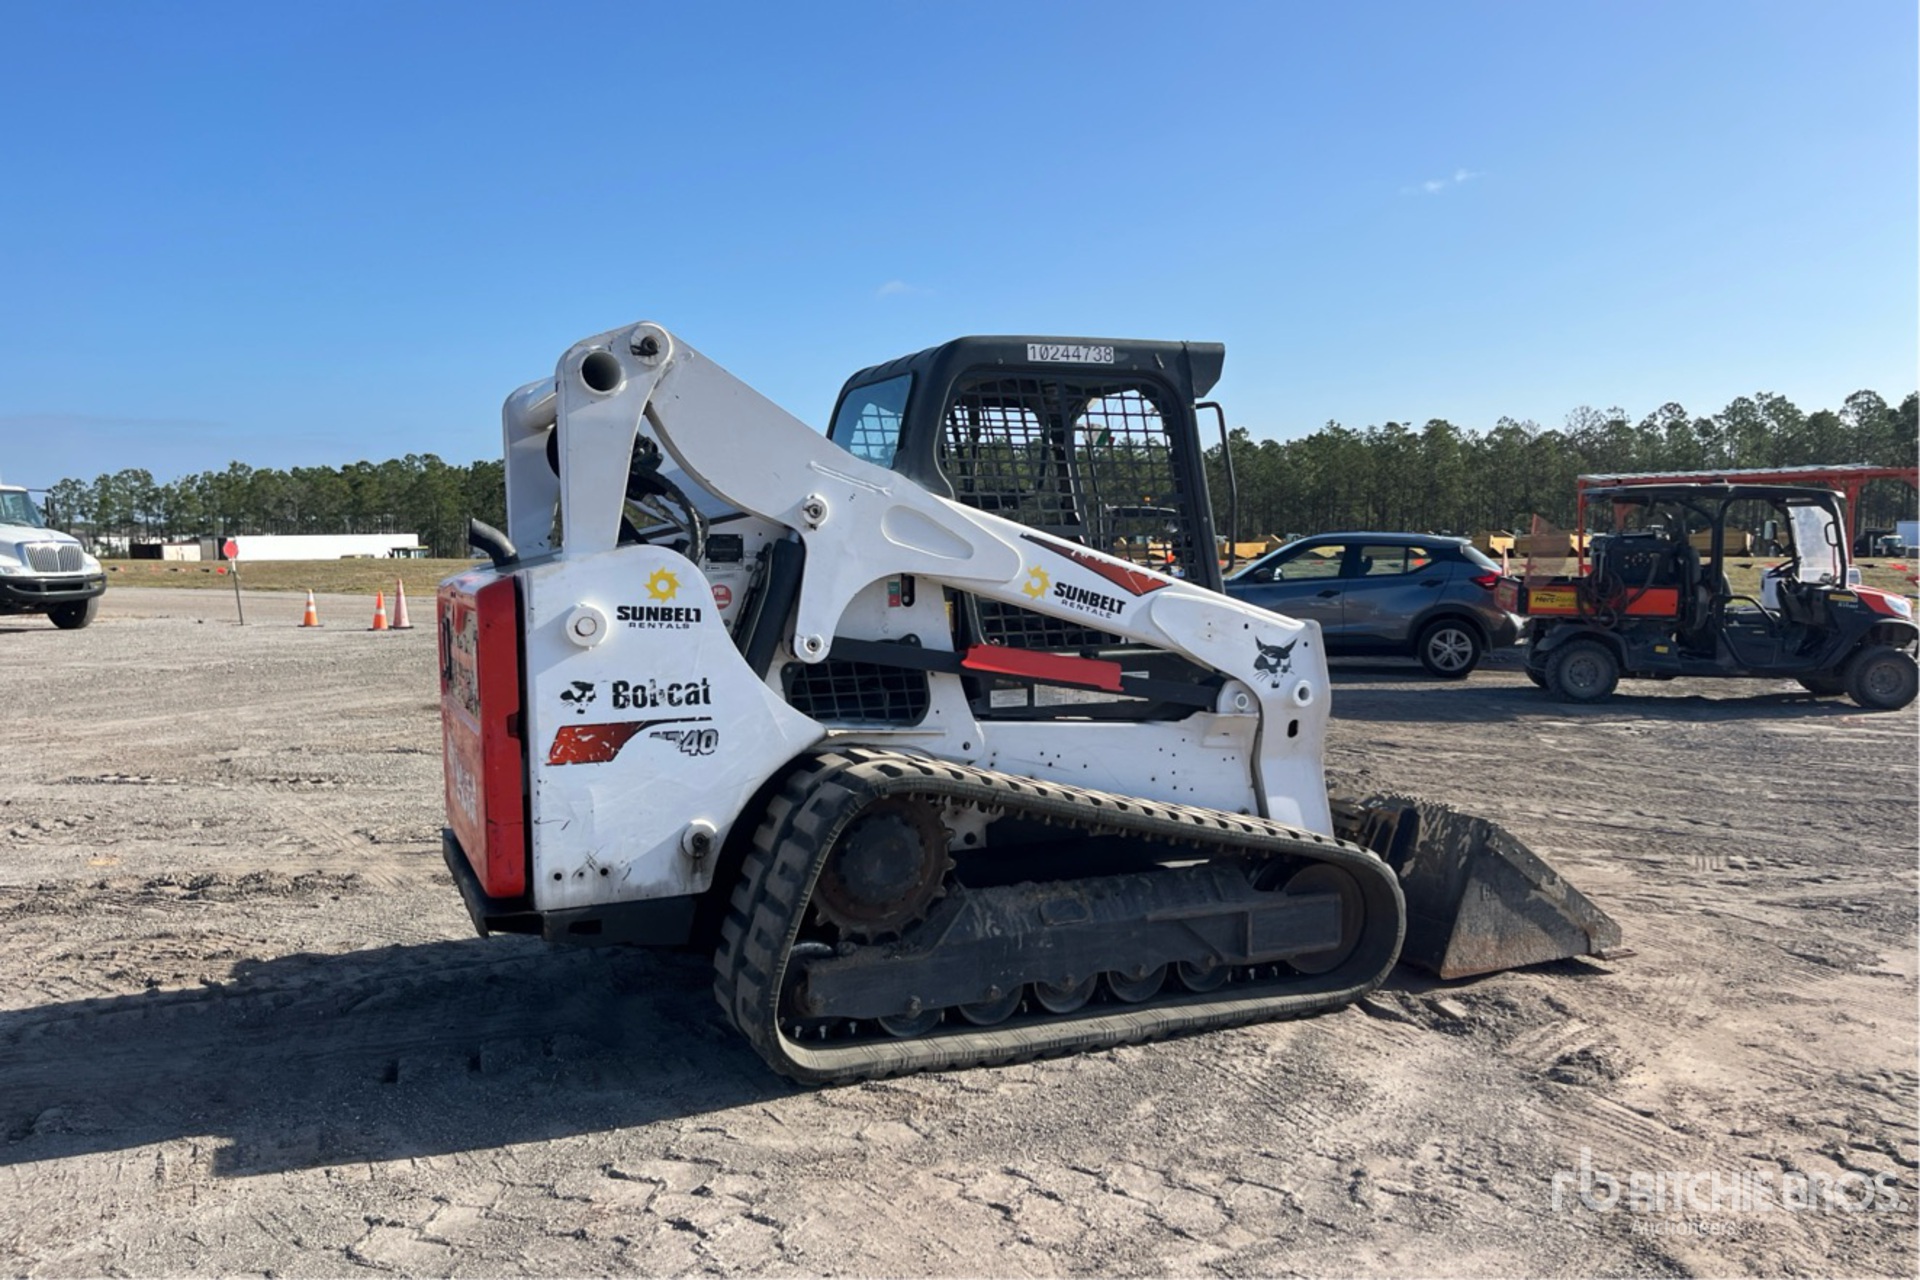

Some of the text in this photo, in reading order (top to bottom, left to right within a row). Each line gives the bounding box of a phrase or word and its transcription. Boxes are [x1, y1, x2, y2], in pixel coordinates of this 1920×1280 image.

[1029, 346, 1114, 362] 10244738
[1054, 581, 1126, 615] SUNBELT
[616, 605, 702, 623] SUNBELT
